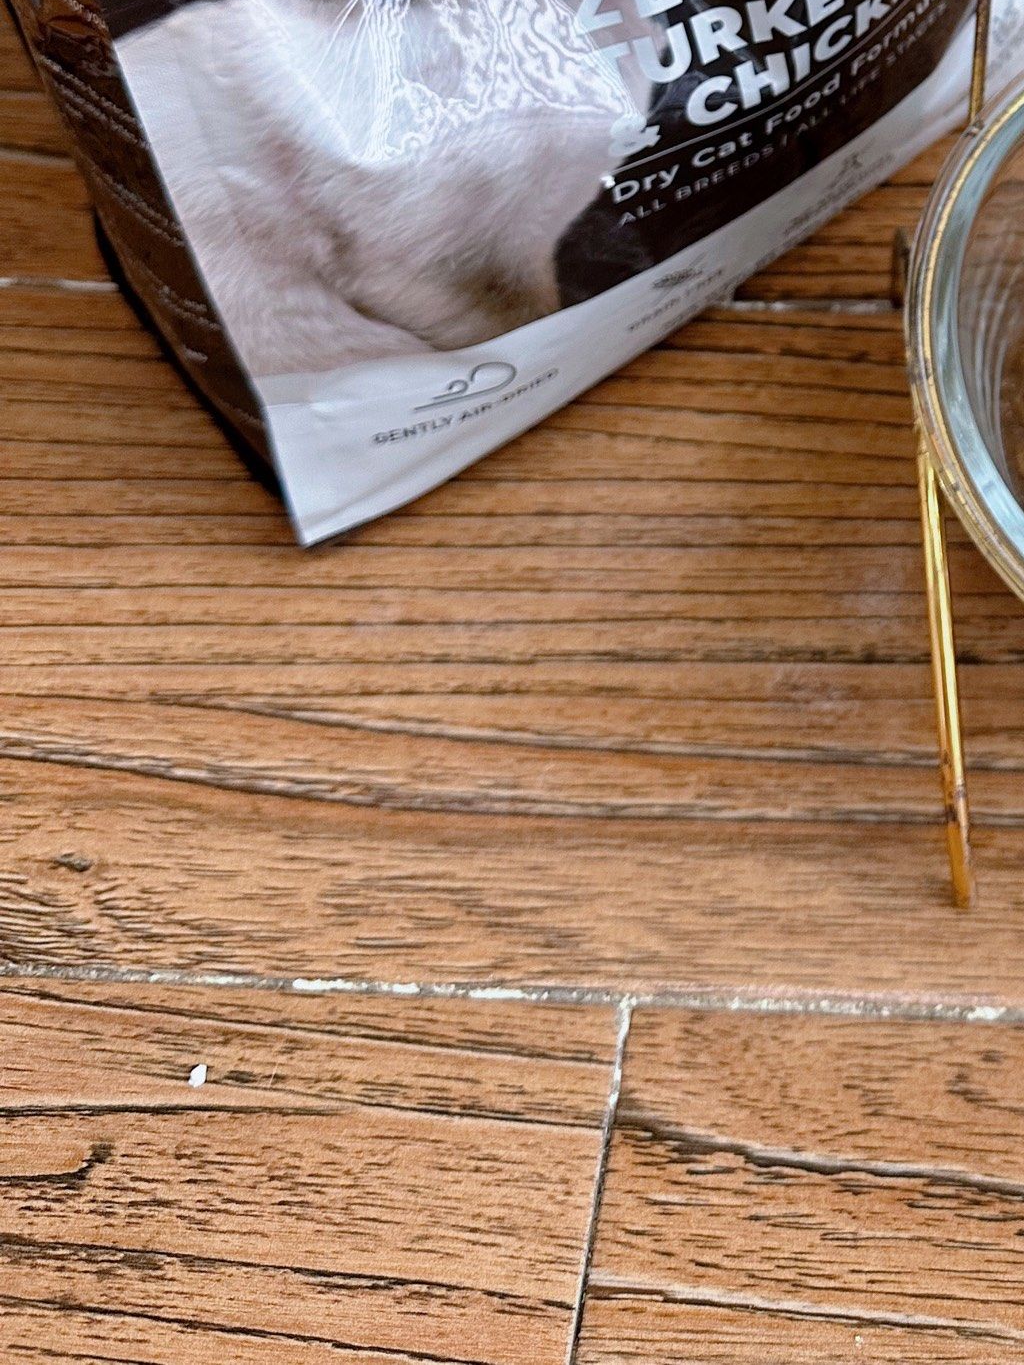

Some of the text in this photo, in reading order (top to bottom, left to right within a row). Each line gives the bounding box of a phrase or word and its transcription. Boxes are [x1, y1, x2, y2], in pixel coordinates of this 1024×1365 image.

[607, 110, 661, 157] &
[611, 164, 680, 206] Dry
[691, 133, 754, 169] Cat
[765, 73, 842, 136] Food
[617, 198, 667, 228] ALL
[675, 144, 775, 202] BREEDS
[373, 413, 454, 446] GENTLY
